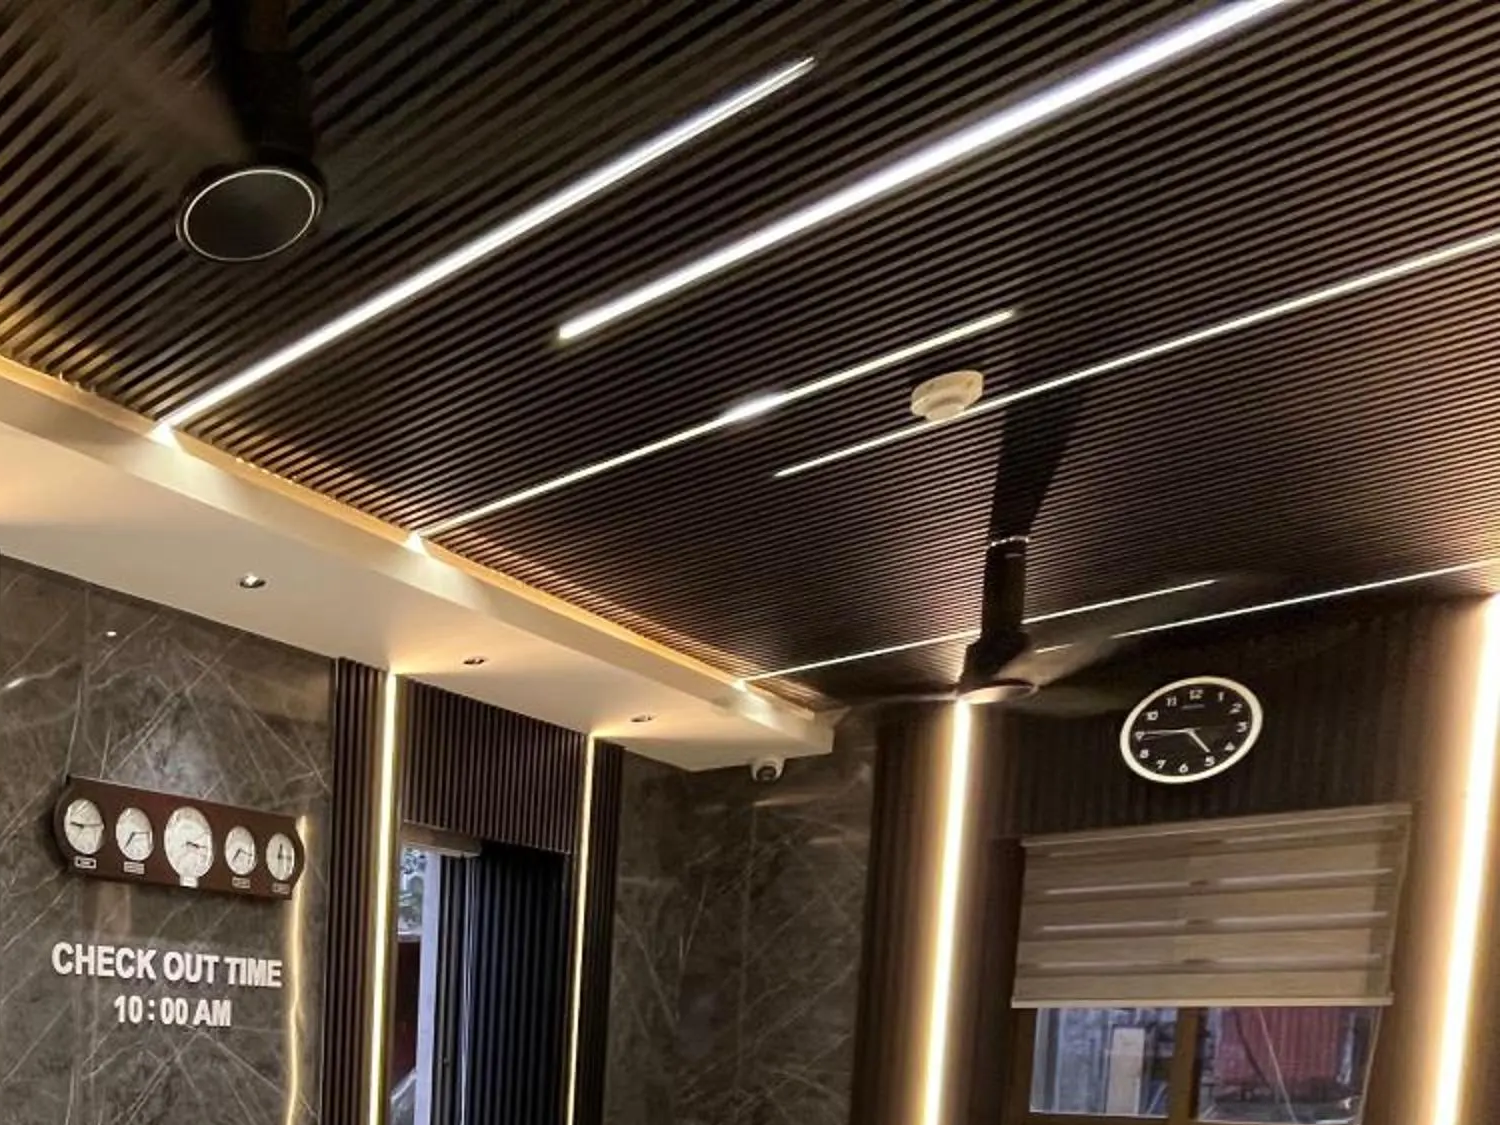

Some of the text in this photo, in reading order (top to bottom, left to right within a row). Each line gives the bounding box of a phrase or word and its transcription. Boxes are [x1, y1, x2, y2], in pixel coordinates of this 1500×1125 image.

[1189, 689, 1204, 700] 12
[1218, 691, 1224, 702] 1
[1166, 697, 1177, 707] 11
[1229, 703, 1242, 715] 2
[1146, 711, 1159, 721] 10
[1236, 721, 1248, 733] 3
[1134, 731, 1145, 742] 9
[1224, 741, 1235, 751] 4
[1139, 749, 1149, 759] 8
[1156, 759, 1167, 770] 7
[1204, 756, 1215, 767] 5
[1178, 763, 1189, 773] 6
[51, 942, 282, 987] CHECK OUT TIME
[192, 999, 232, 1027] AM
